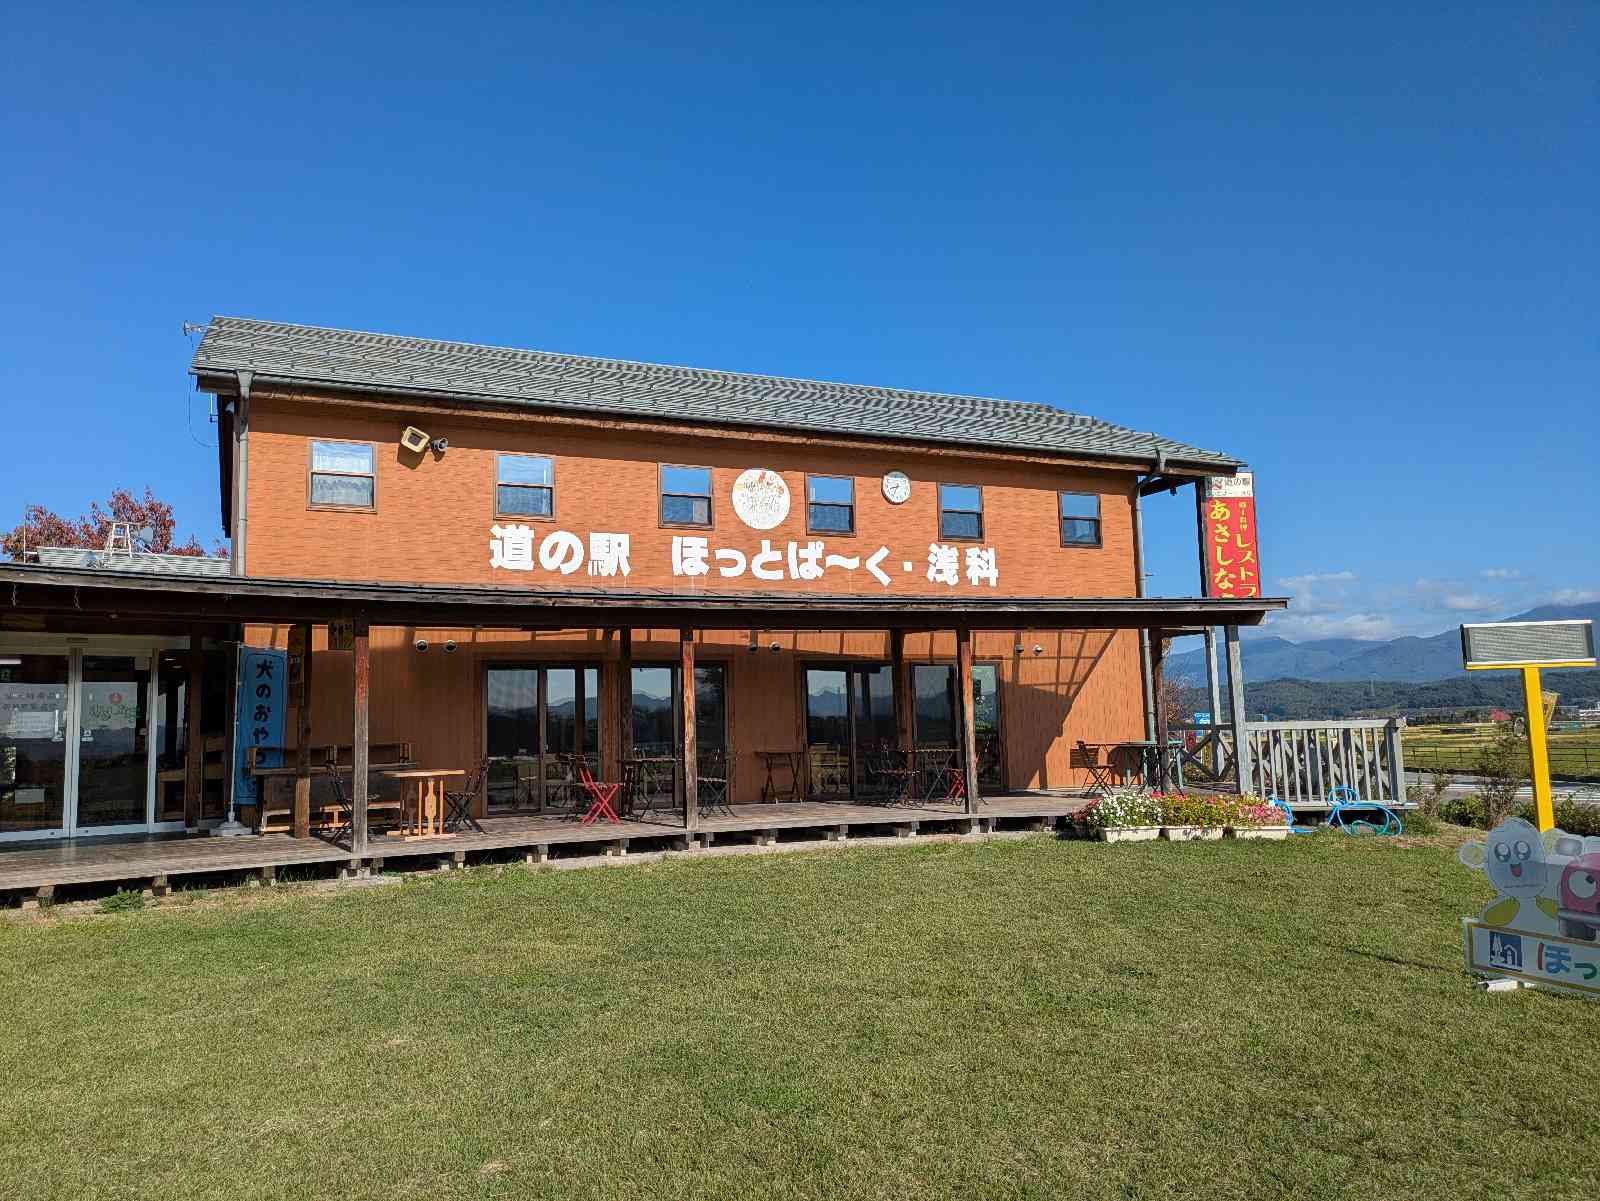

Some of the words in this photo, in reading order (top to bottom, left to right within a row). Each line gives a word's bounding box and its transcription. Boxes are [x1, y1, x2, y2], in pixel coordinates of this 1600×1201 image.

[490, 525, 630, 576] 道の駅
[1210, 499, 1235, 598] あさしな
